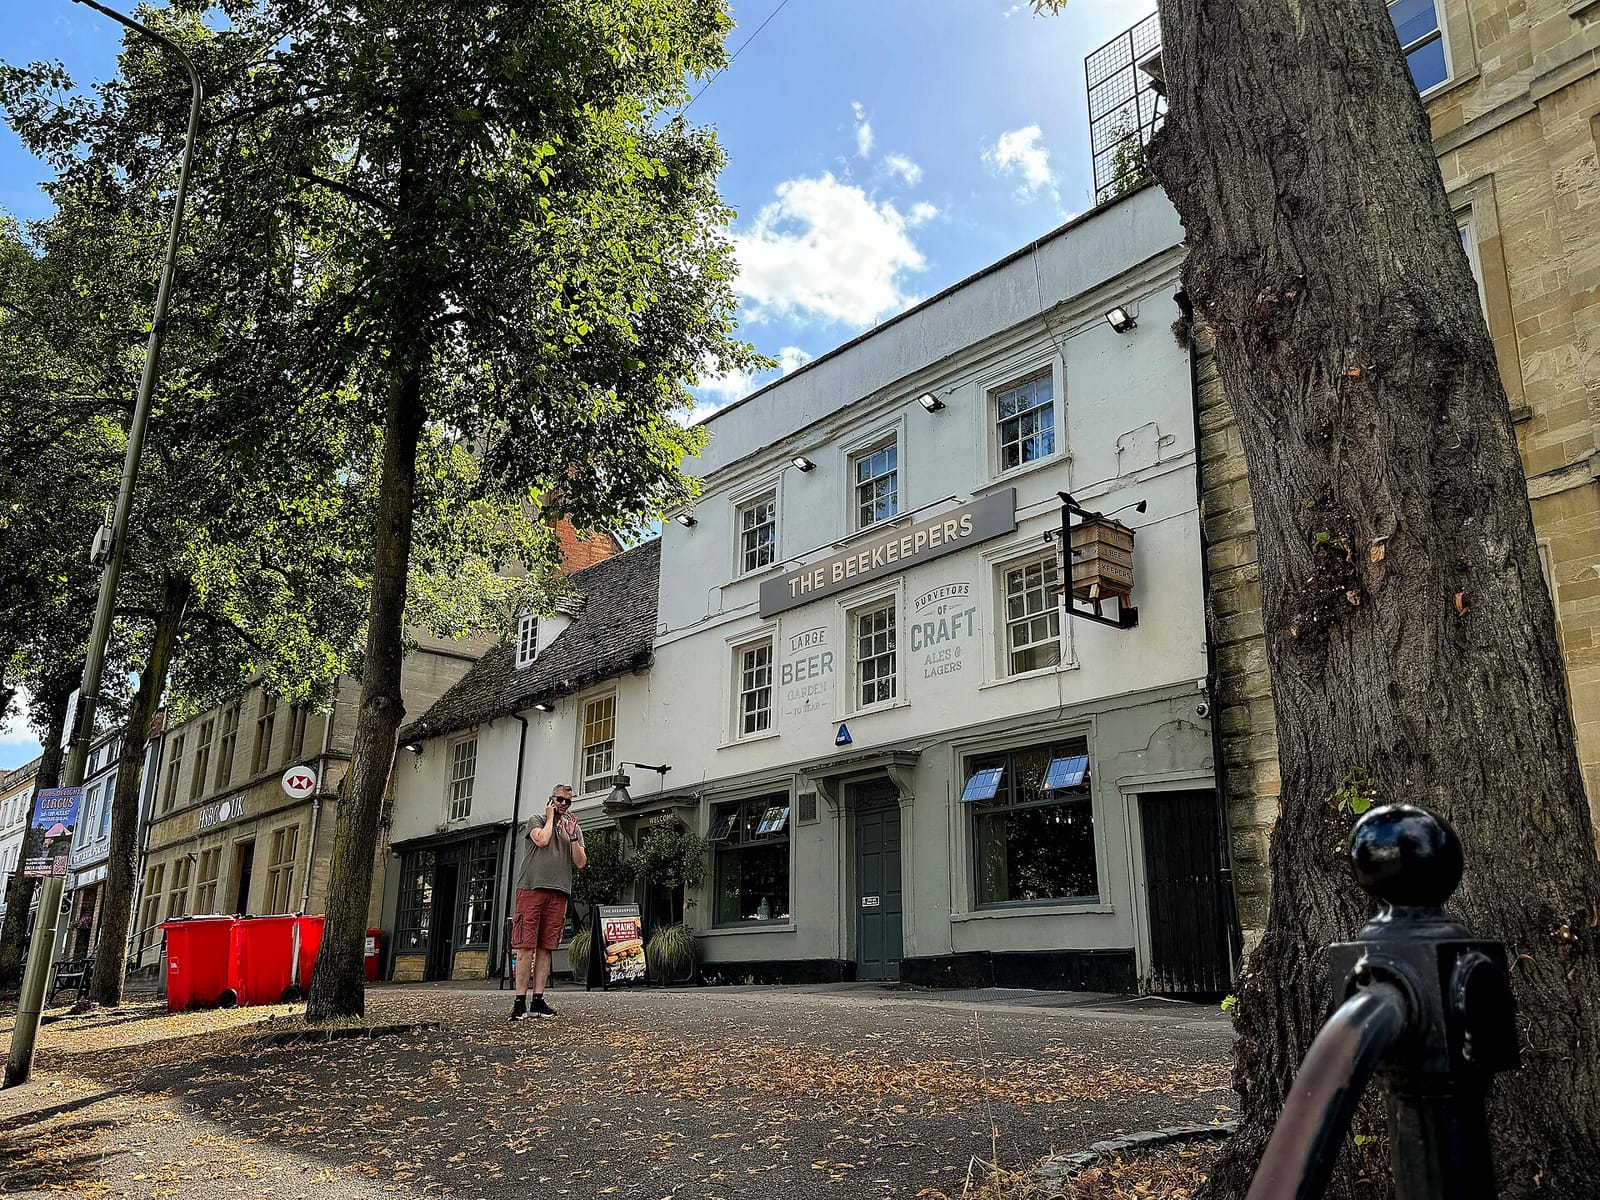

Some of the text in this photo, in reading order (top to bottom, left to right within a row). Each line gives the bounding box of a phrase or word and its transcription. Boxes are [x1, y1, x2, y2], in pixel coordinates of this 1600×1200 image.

[788, 513, 974, 598] THE BEEKEEPERS
[1109, 550, 1122, 559] BEE
[1101, 564, 1131, 578] KEEPERS
[915, 585, 969, 609] PURVEYORS
[937, 604, 948, 615] OF
[911, 606, 976, 652] CRAFT
[791, 631, 825, 651] LARGE
[924, 646, 962, 665] ALES &
[781, 651, 834, 686] BEER
[924, 661, 962, 679] LAGERS
[787, 681, 827, 701] GARDEN
[793, 706, 802, 715] TO
[41, 797, 74, 809] CIRCUS
[199, 796, 246, 829] HSBC UK
[649, 813, 675, 825] WELCOME
[607, 922, 635, 936] 2 MAINS
